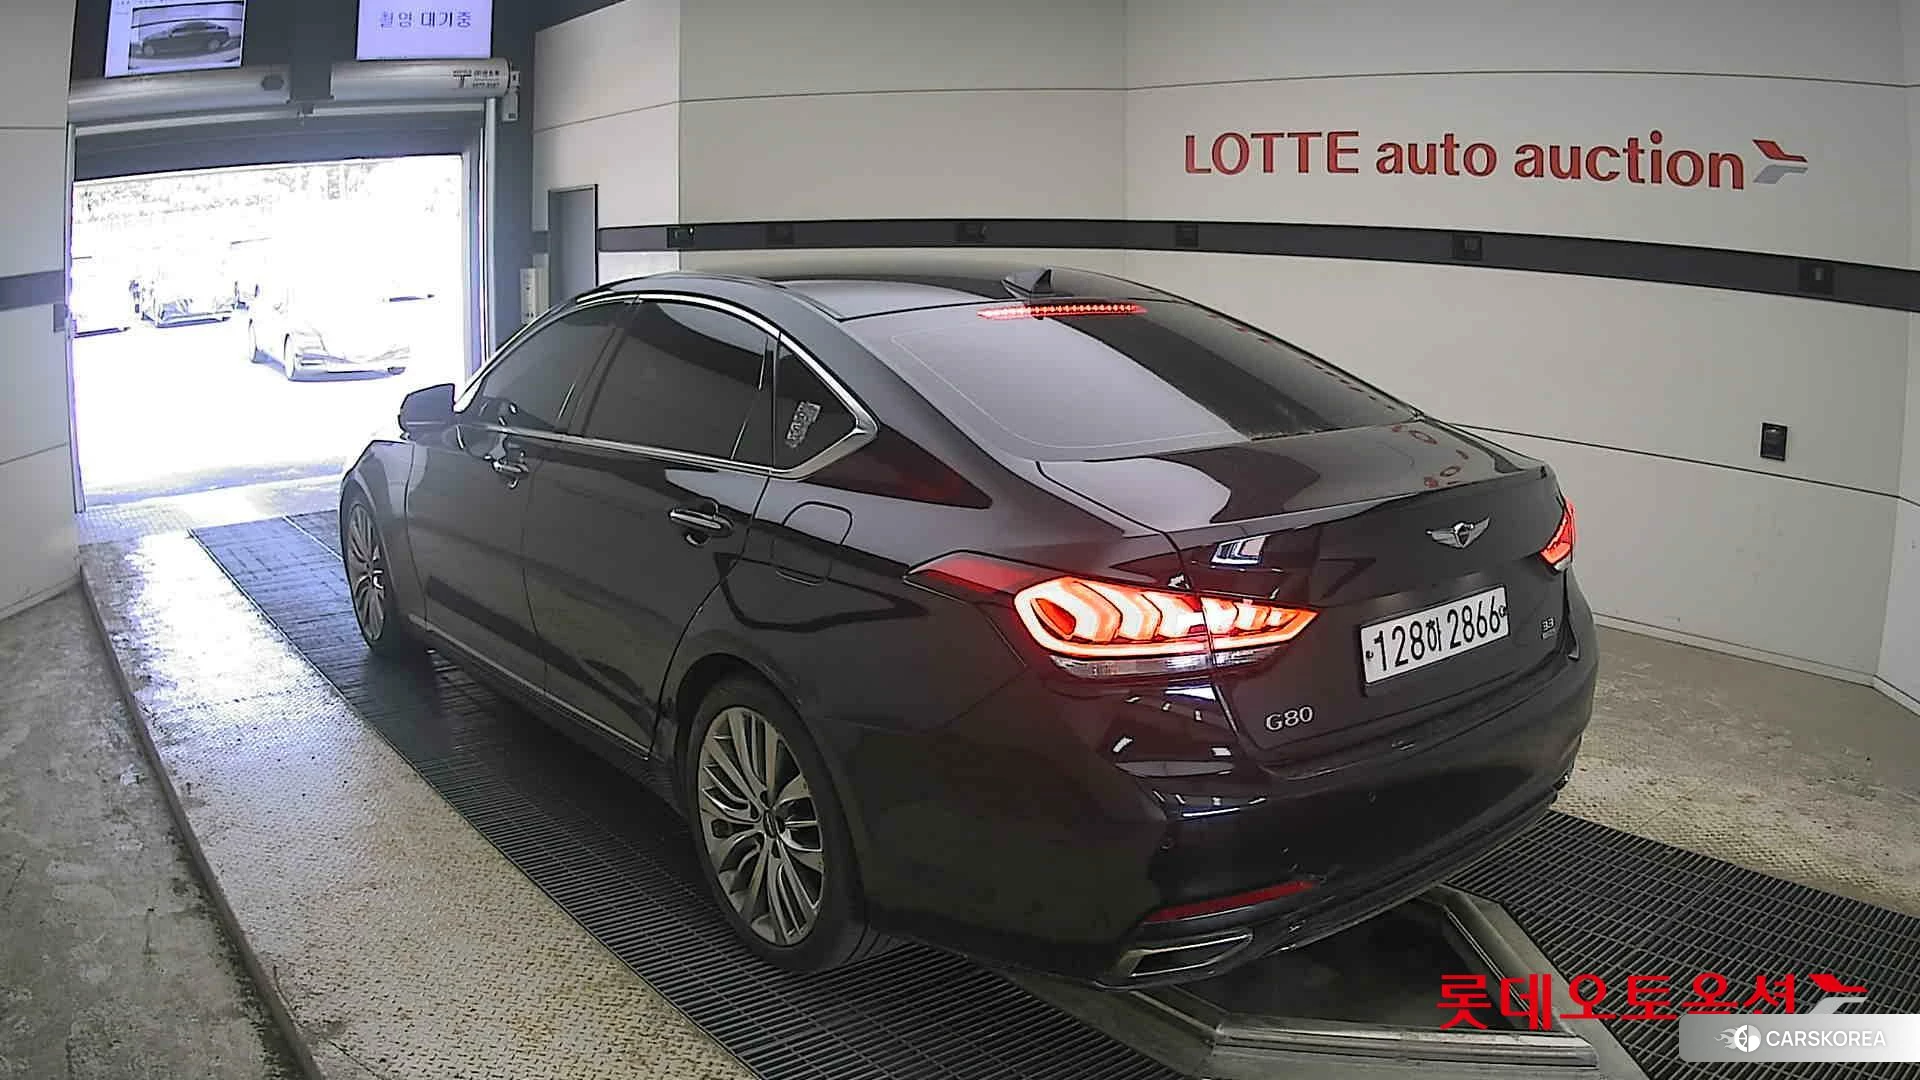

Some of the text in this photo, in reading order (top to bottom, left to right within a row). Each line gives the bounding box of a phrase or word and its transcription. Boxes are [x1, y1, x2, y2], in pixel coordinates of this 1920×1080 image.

[421, 11, 471, 28] 대기중
[1185, 129, 1744, 190] LOTTE auto auction
[1374, 596, 1502, 671] 128하 2866
[1266, 706, 1314, 731] G80
